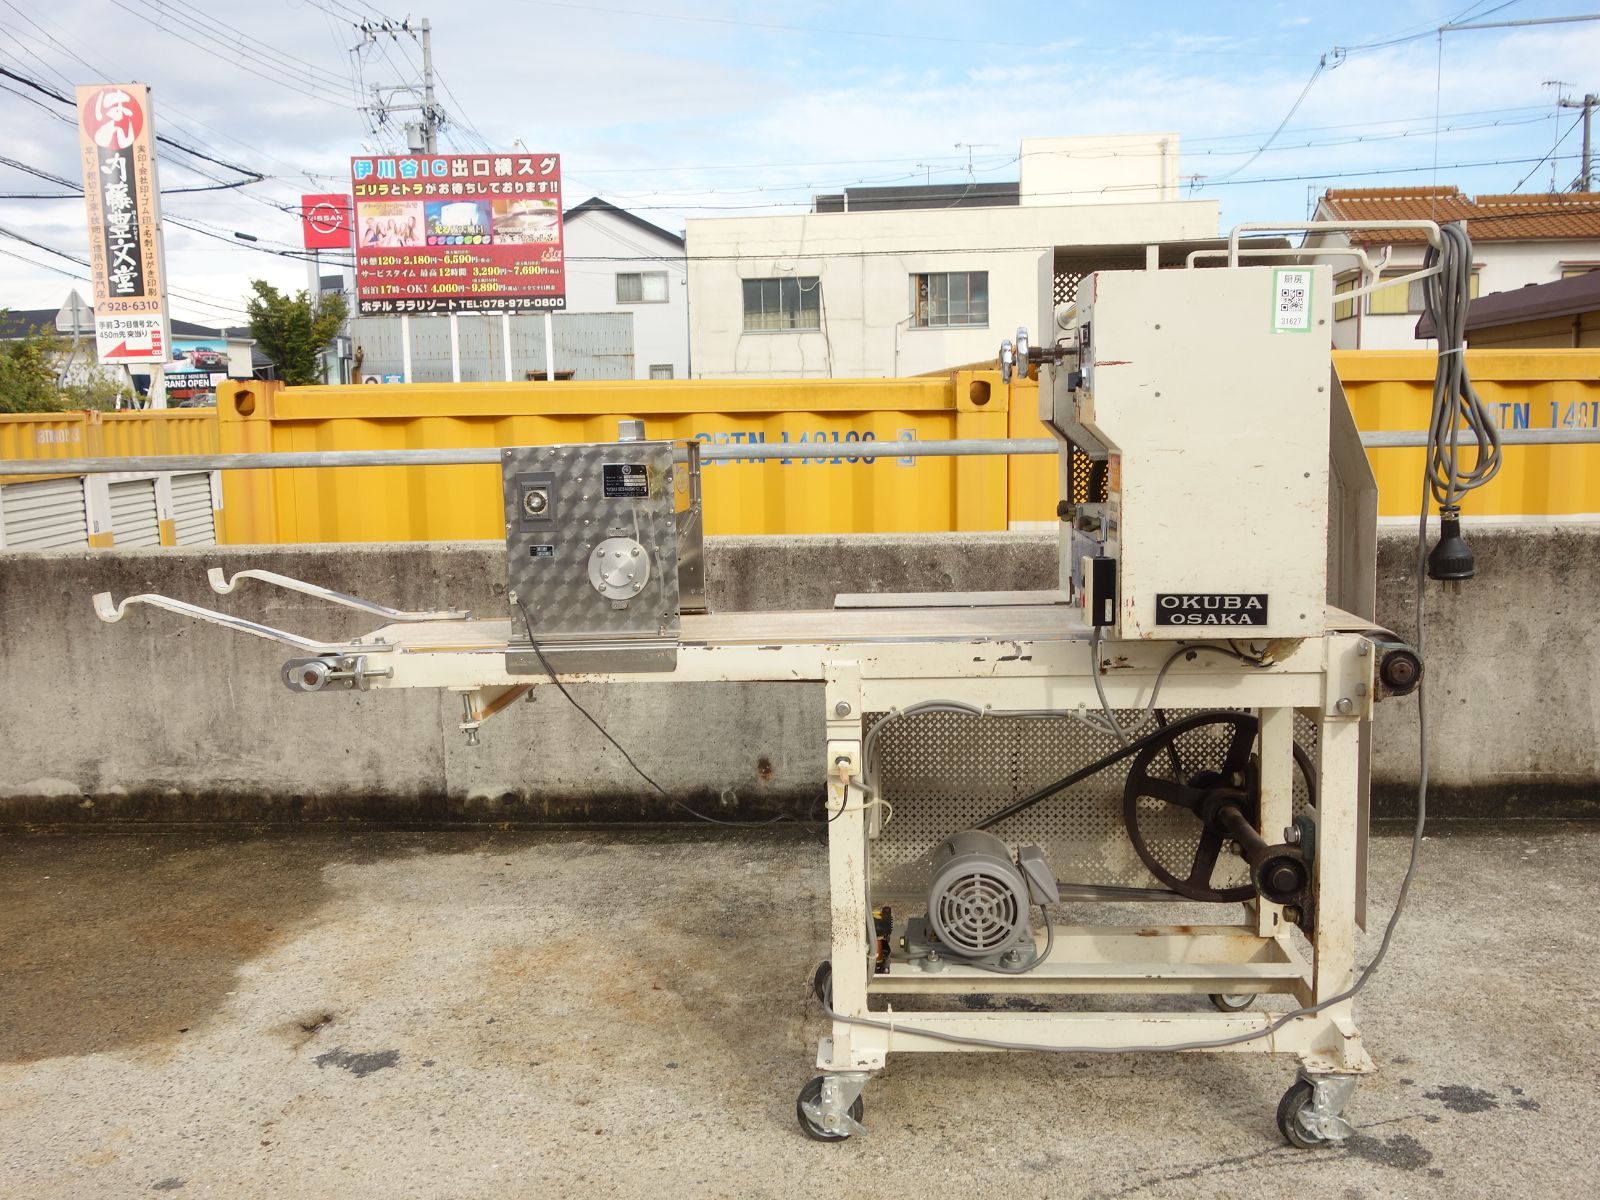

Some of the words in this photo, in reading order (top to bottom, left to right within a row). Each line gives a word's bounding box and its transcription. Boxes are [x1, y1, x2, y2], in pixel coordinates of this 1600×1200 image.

[94, 89, 135, 149] はん
[308, 214, 343, 222] NISSAN
[361, 268, 417, 278] サービスタイム
[1284, 274, 1303, 284] 厨房
[107, 301, 158, 312] 928-6310
[361, 301, 393, 312] ホテル
[395, 299, 457, 311] ララリゾート
[458, 298, 564, 309] TEL:078-975-0800
[1281, 317, 1302, 325] 31627
[187, 379, 210, 387] OPEN
[1161, 596, 1263, 609] OKUBA
[1170, 613, 1253, 625] OSAKA
